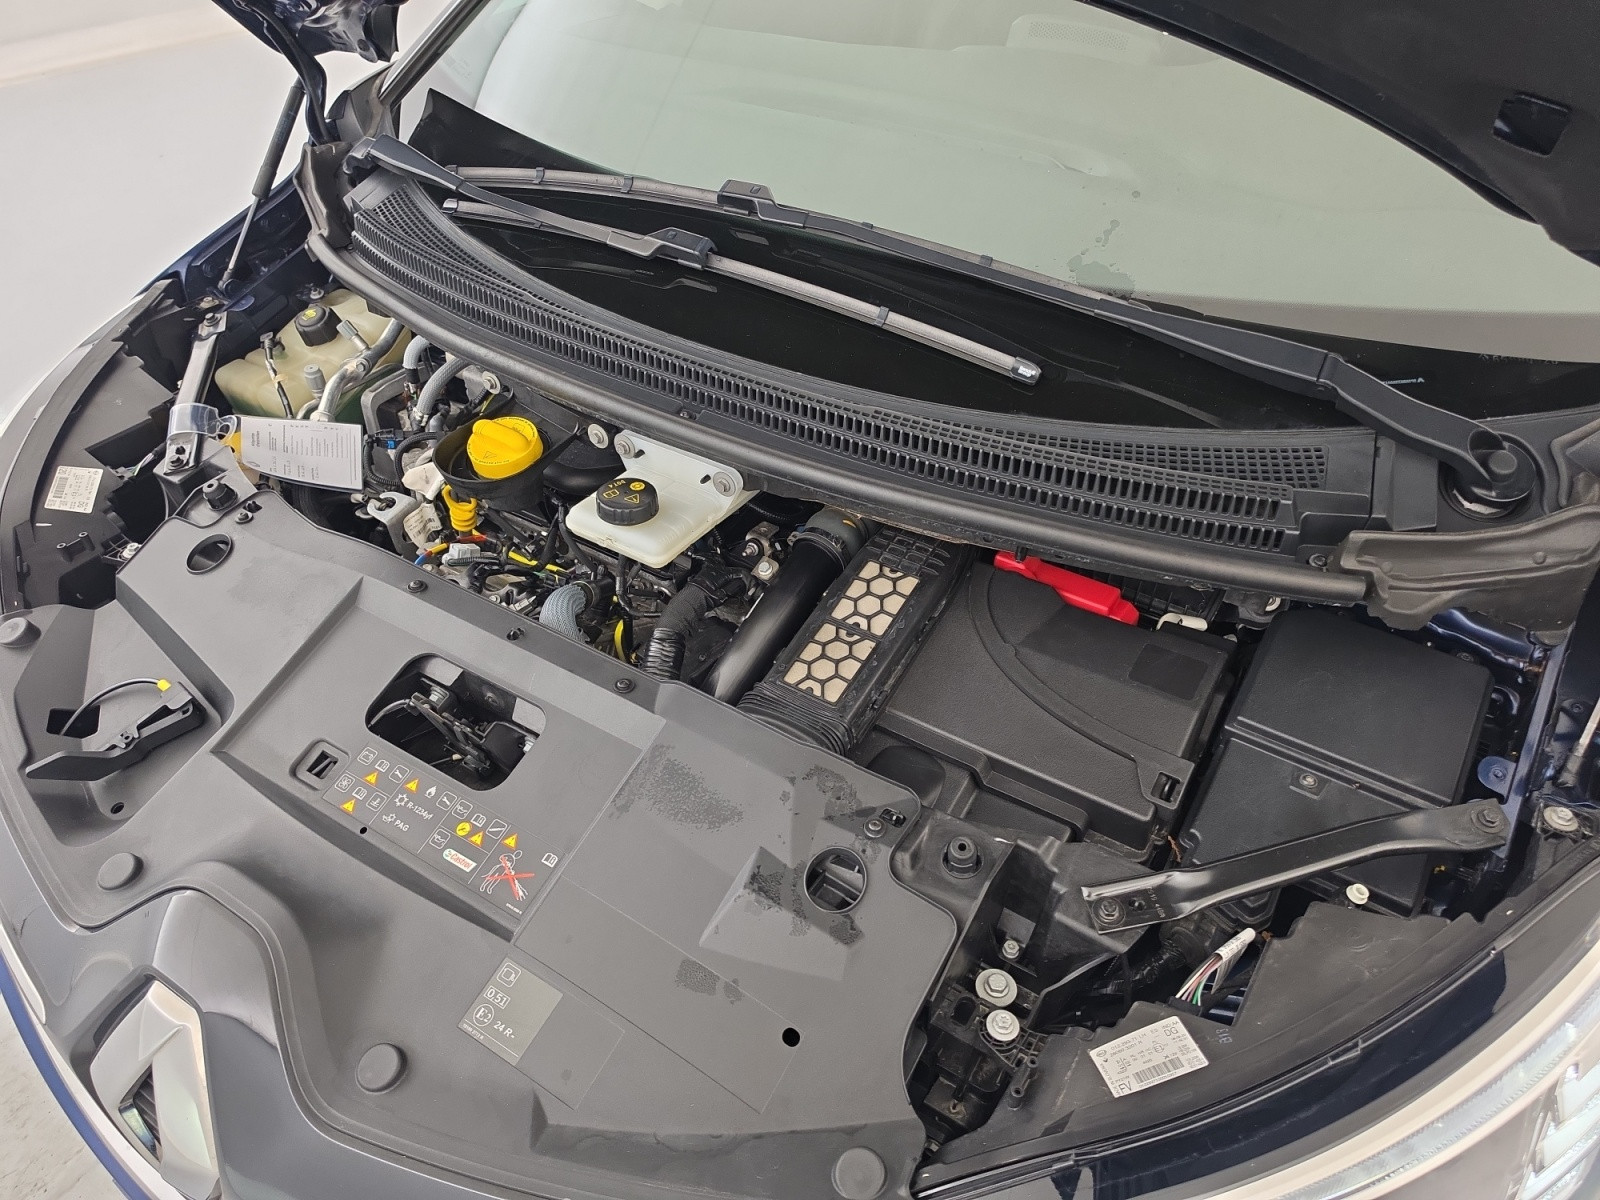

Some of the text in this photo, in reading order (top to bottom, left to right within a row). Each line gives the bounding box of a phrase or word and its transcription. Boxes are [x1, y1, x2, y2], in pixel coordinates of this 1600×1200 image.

[407, 801, 434, 820] R-1234yf
[394, 820, 409, 831] PAG
[450, 853, 473, 870] Castrol
[476, 1007, 492, 1023] E2
[493, 1021, 506, 1032] 24
[1164, 1027, 1178, 1036] DG
[1119, 1081, 1132, 1094] FV
